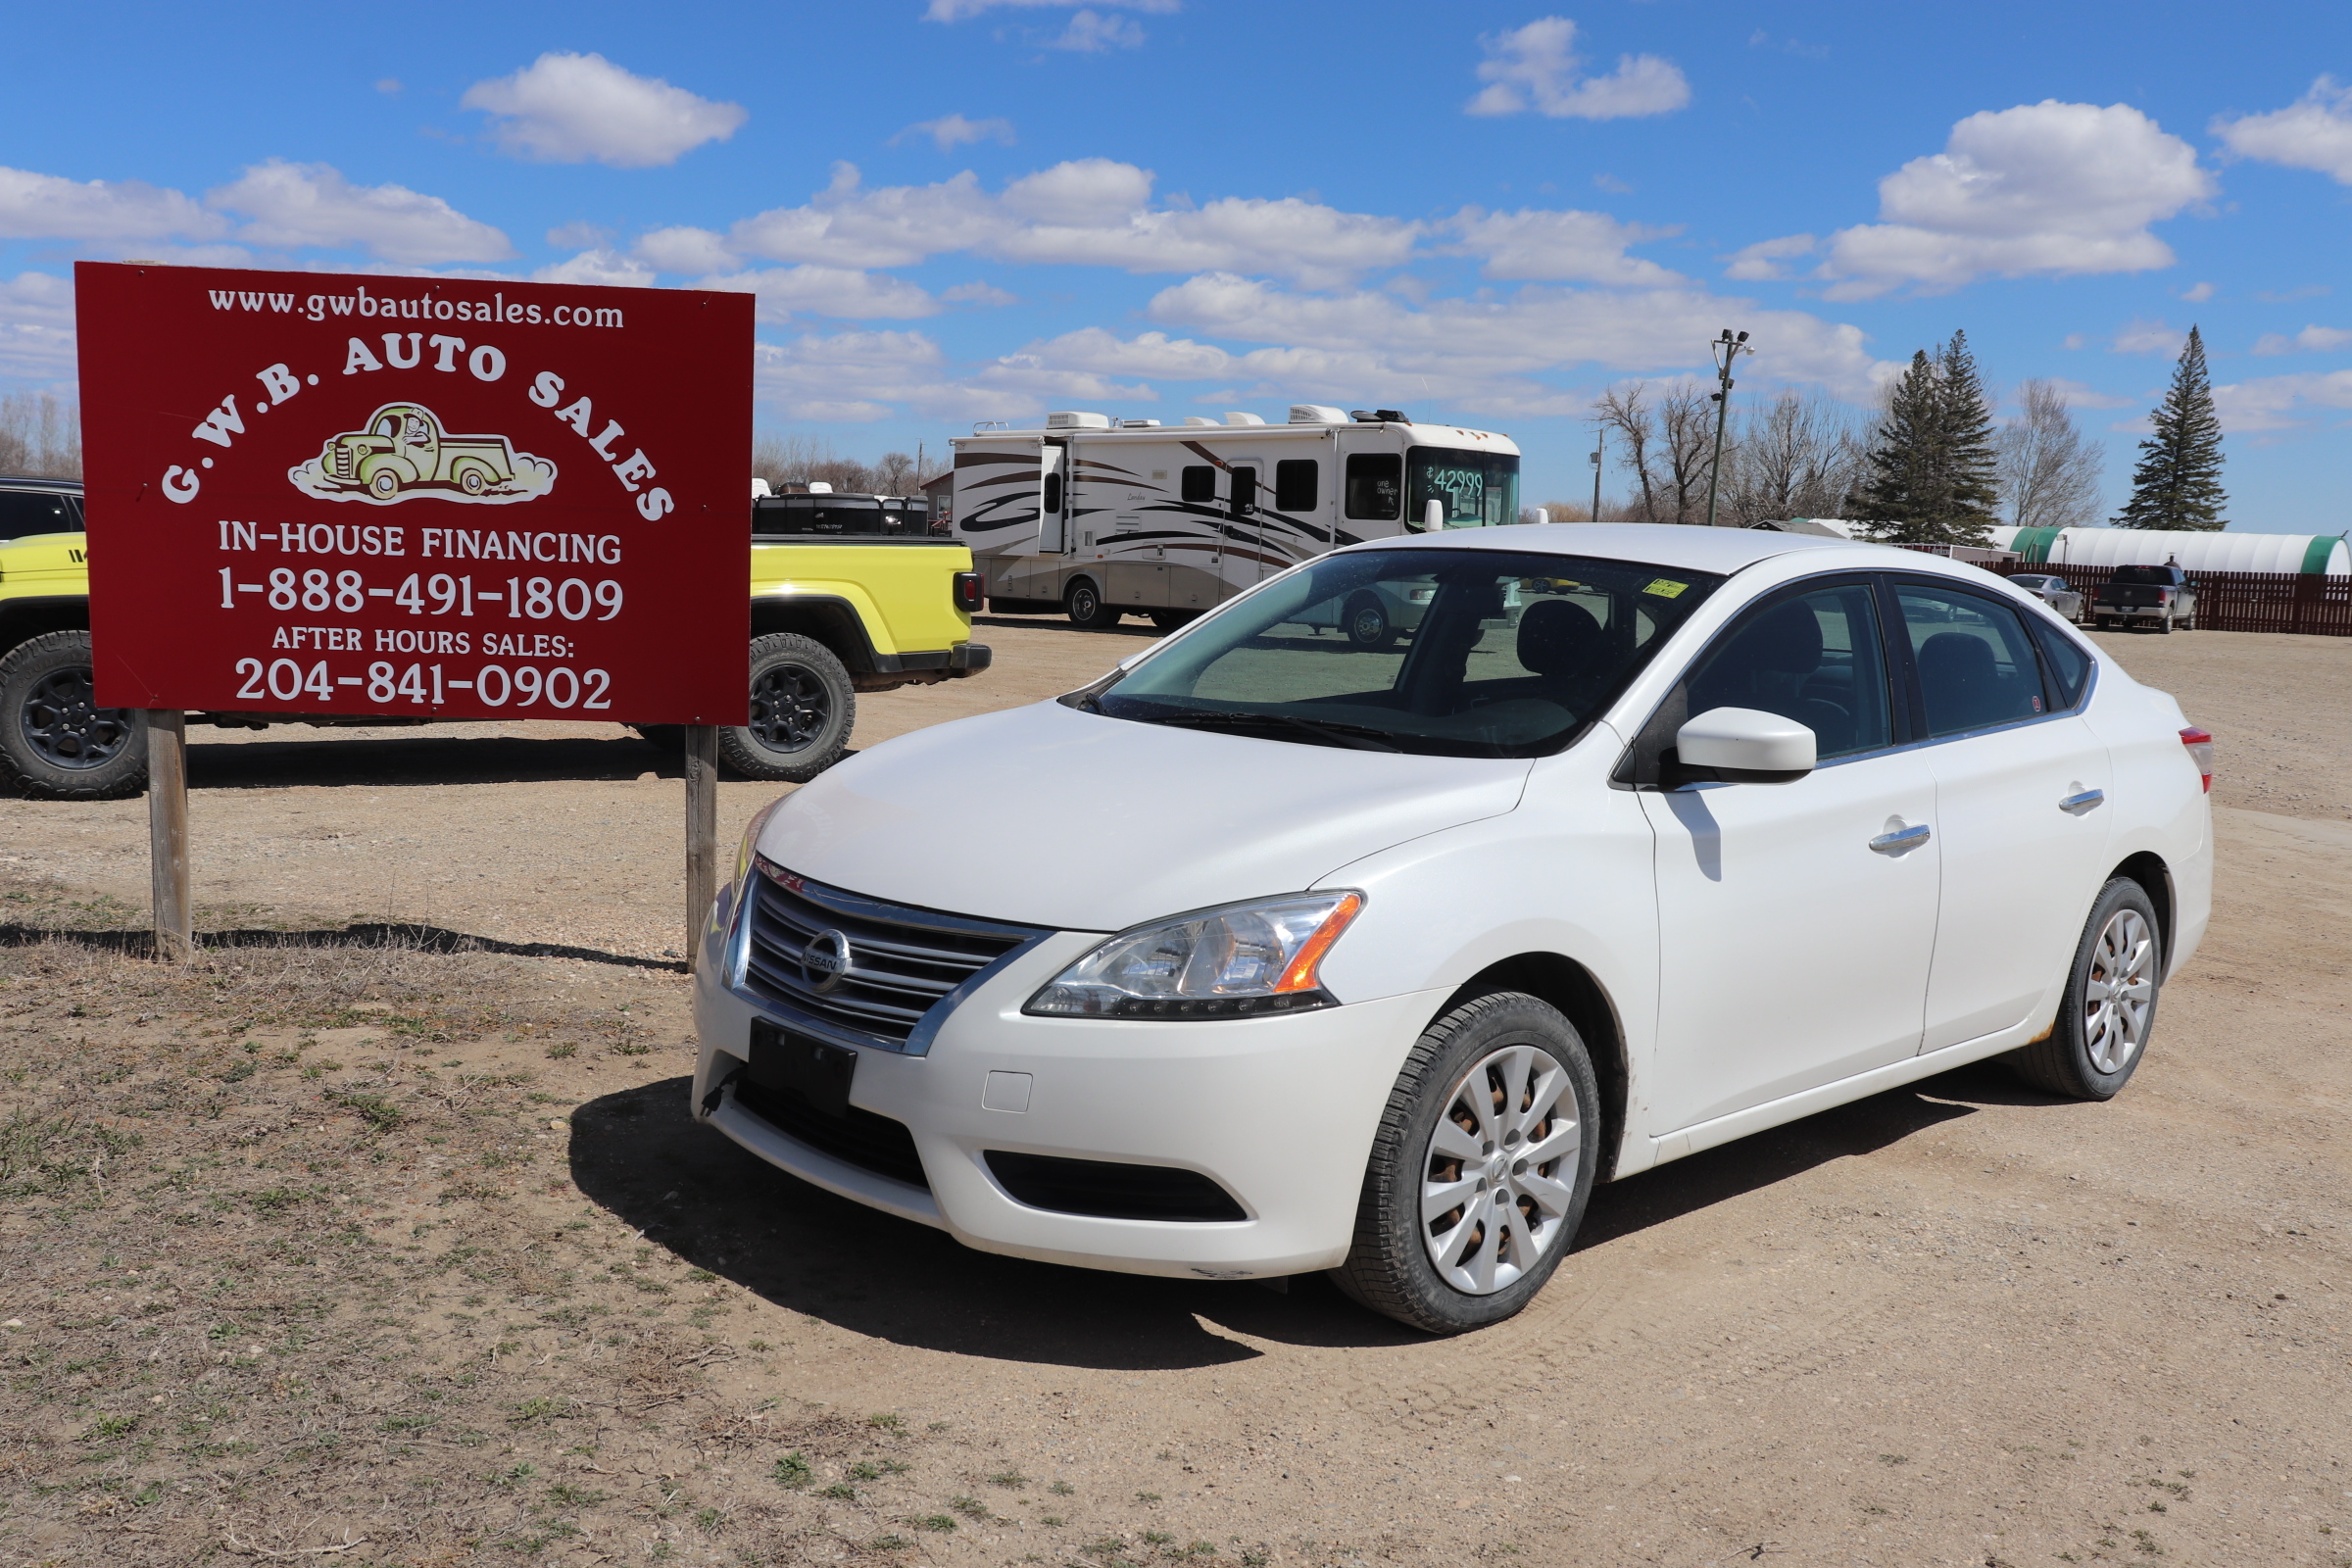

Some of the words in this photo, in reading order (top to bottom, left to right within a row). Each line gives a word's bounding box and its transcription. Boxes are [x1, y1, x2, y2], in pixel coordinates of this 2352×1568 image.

[208, 285, 624, 329] www.gwbautosales.com
[161, 363, 319, 505] G.W.B.
[342, 332, 507, 383] AUTO
[528, 370, 675, 521] SALES
[1377, 487, 1398, 496] owner
[218, 520, 406, 559] IN-HOUSE
[421, 527, 622, 565] FINANCING
[218, 566, 624, 622] 1-888-491-1809
[271, 625, 364, 652] AFTER
[374, 629, 471, 656] HOURS
[481, 631, 575, 660] SALES:
[235, 656, 612, 710] 204-841-0902
[804, 953, 837, 970] NISSAN
